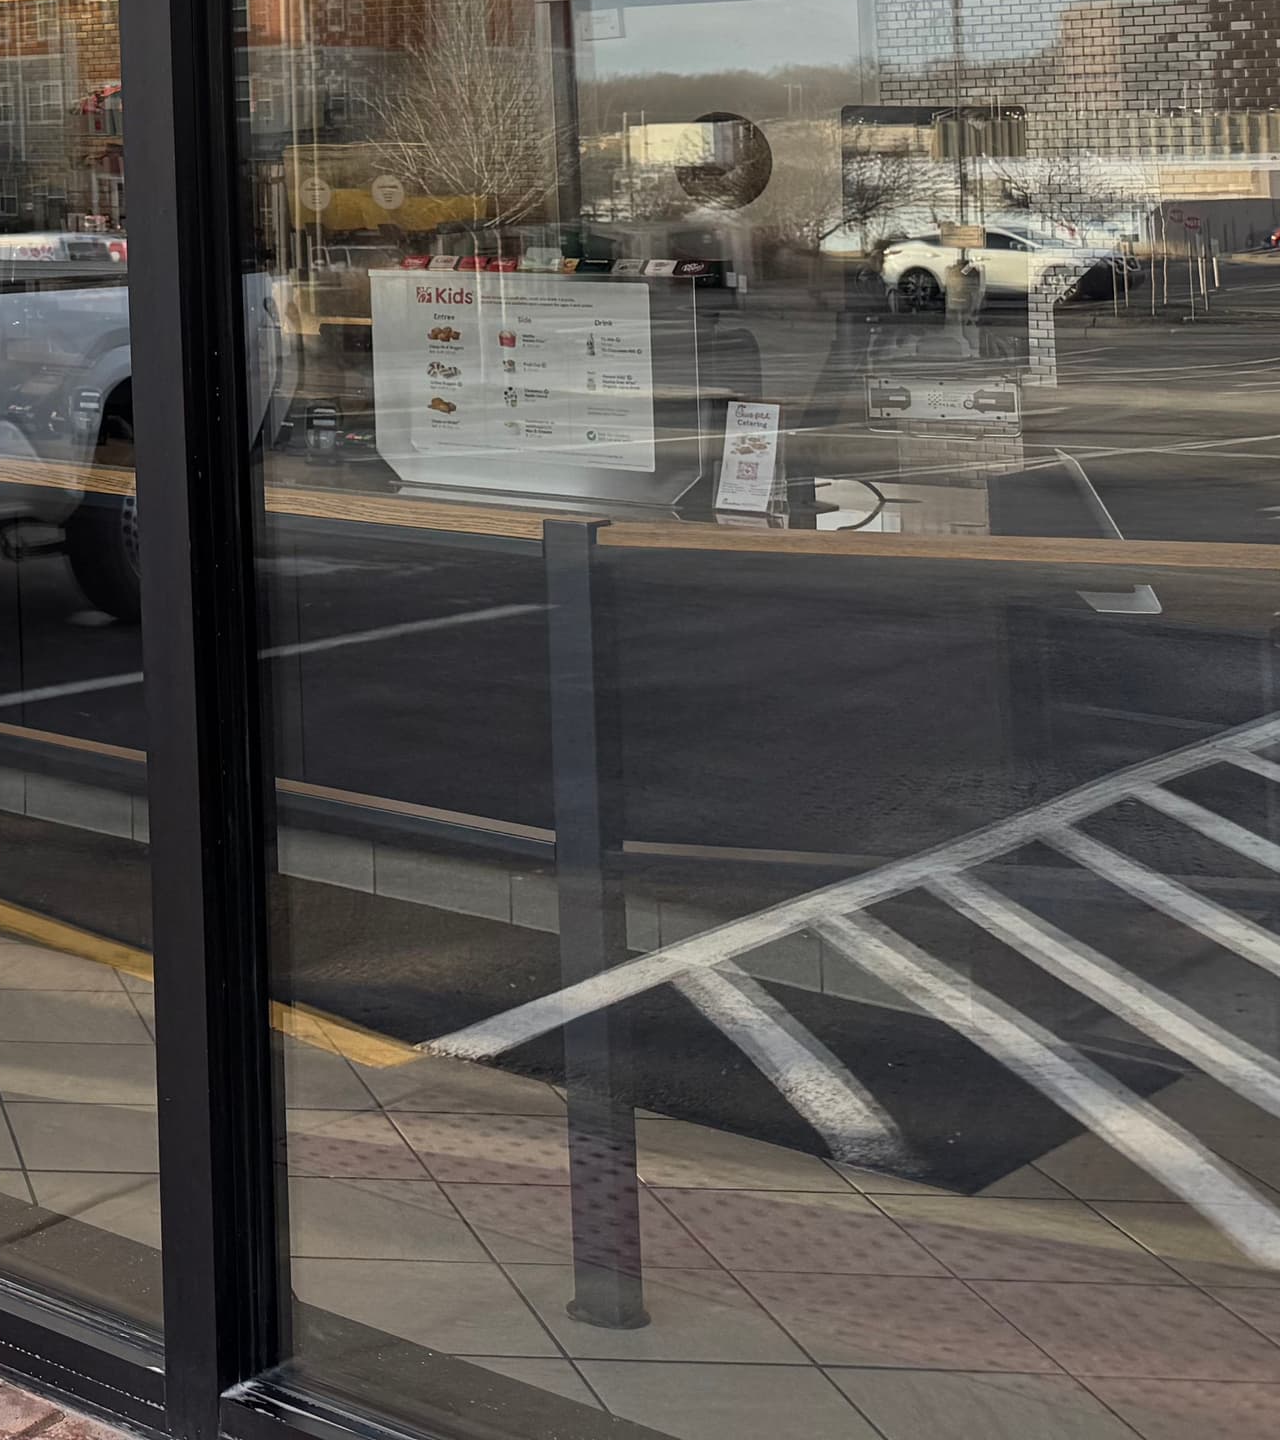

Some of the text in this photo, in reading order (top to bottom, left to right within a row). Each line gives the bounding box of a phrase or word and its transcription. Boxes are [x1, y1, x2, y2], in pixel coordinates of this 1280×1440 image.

[435, 287, 474, 305] Kids
[594, 318, 613, 327] Drink
[737, 420, 768, 429] Catering
